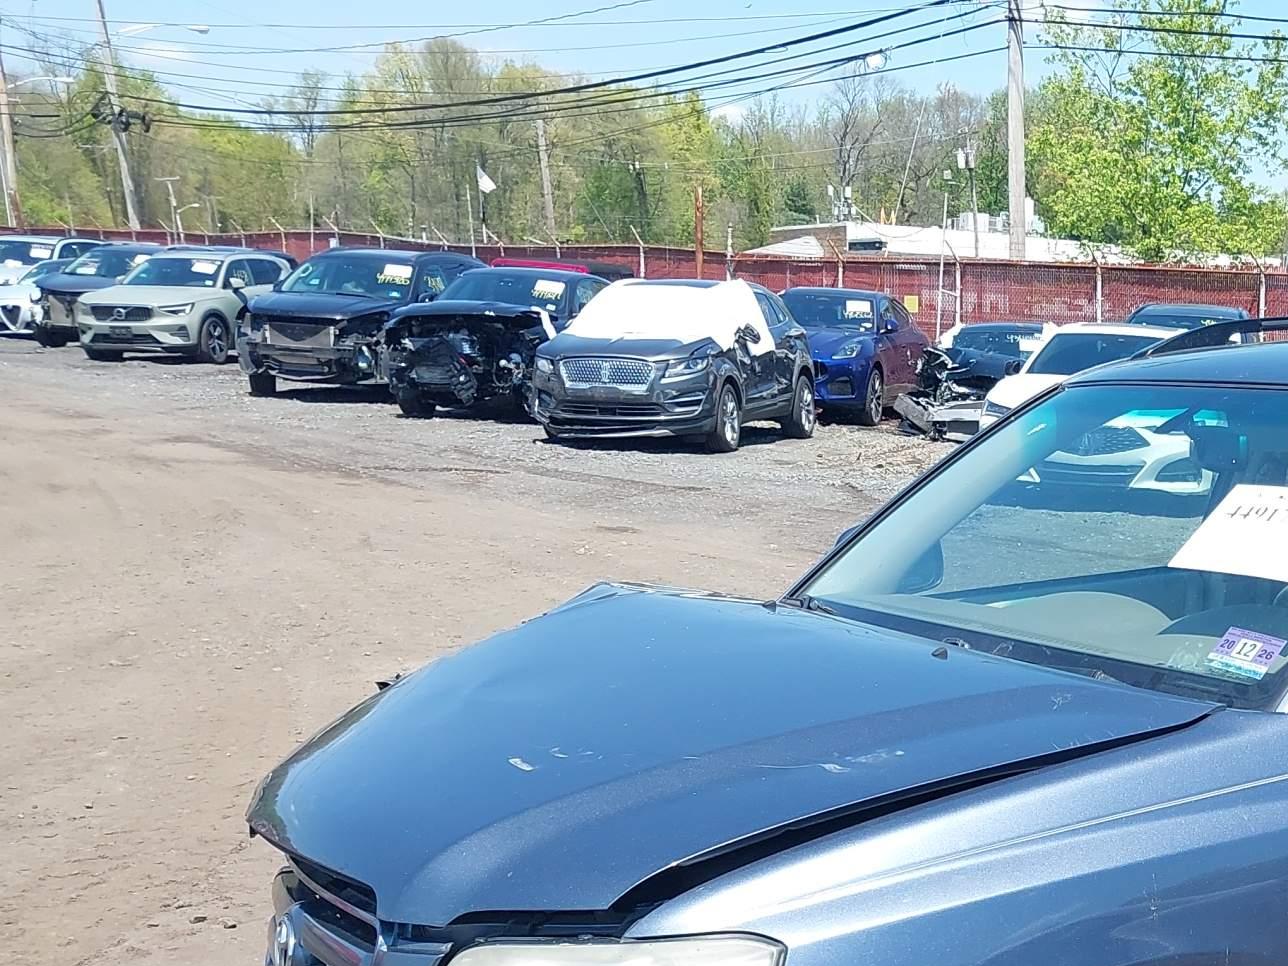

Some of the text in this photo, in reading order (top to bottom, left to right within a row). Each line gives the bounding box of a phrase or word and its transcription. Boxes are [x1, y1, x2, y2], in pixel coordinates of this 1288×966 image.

[1220, 638, 1275, 660] 20 12 26
